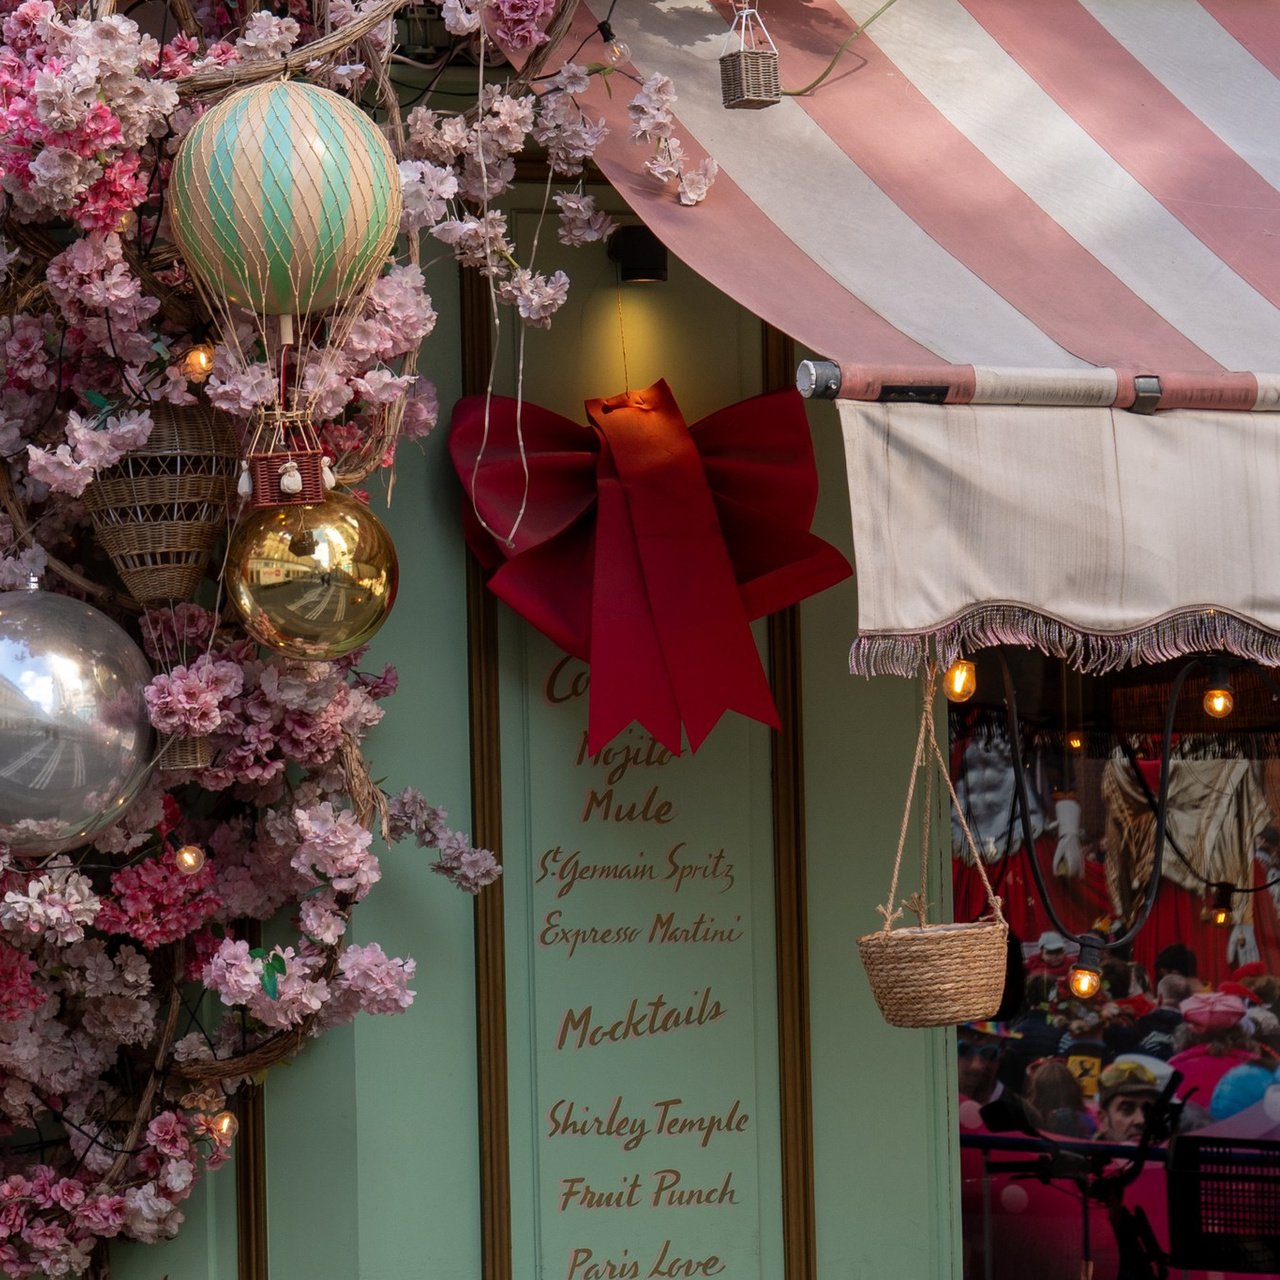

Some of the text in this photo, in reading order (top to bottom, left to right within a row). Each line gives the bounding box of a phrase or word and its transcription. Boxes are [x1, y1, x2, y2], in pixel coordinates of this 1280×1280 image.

[582, 785, 679, 824] Mule
[664, 842, 735, 894] Spritz
[539, 910, 744, 958] Expresso Martini
[557, 986, 728, 1051] Mocktails
[548, 1096, 749, 1151] Shirley Temple
[560, 1169, 743, 1212] Fruit Punch
[648, 1240, 726, 1279] Love
